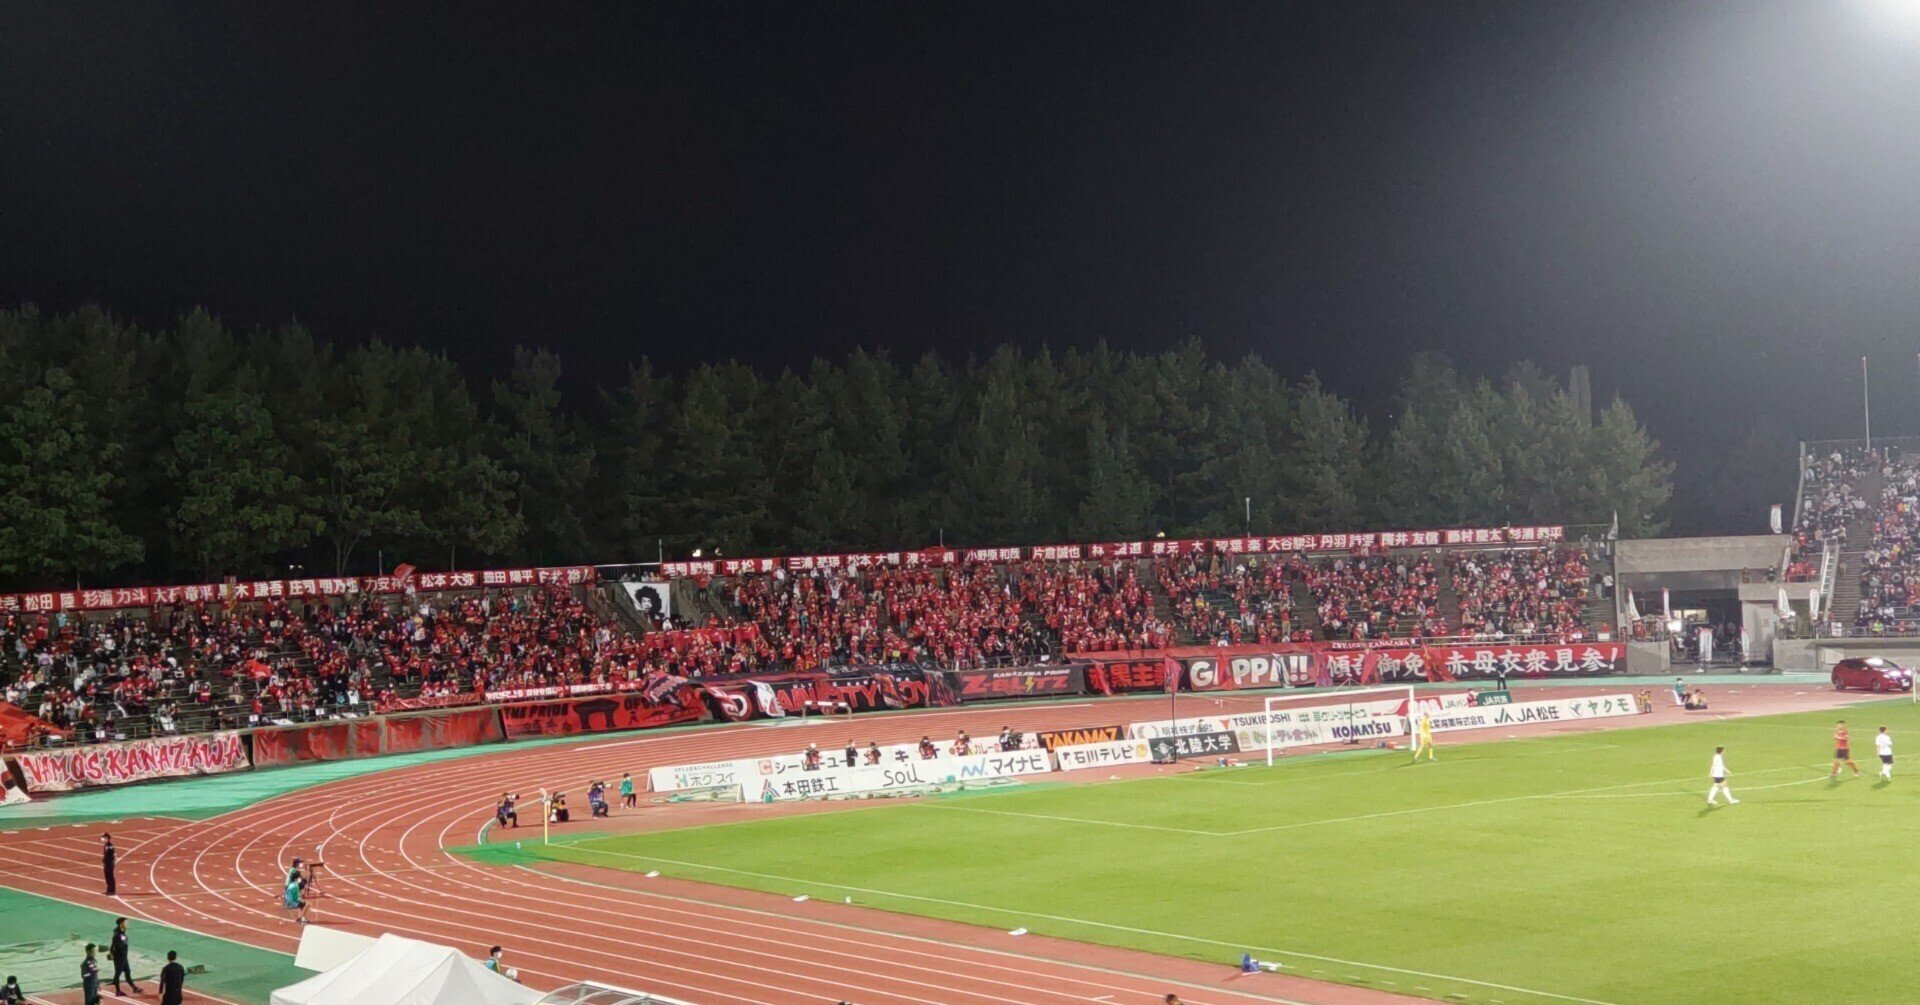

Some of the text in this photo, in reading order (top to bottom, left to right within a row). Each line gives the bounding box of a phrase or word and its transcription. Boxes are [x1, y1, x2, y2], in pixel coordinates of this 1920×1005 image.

[1320, 534, 1347, 549] 丹羽
[1411, 531, 1439, 545] 友信
[789, 556, 813, 570] 三浦
[289, 580, 316, 596] 庄司
[421, 574, 446, 588] 松本
[25, 594, 53, 611] 松田
[60, 593, 75, 609] 陸
[82, 588, 146, 608] 杉浦 力斗
[184, 585, 213, 602] 竜平
[1368, 640, 1410, 648] KANAZAWA
[1517, 705, 1560, 722] JA松任
[1588, 697, 1630, 715] ヤクモ
[1331, 721, 1392, 739] KOMATSU
[1174, 734, 1232, 756] 北陸大学
[22, 734, 243, 786] VAMOS KANAZAWA
[1073, 745, 1134, 764] 石川テレビ
[989, 754, 1044, 774] マイナビ
[782, 777, 839, 796] 本田鉄工
